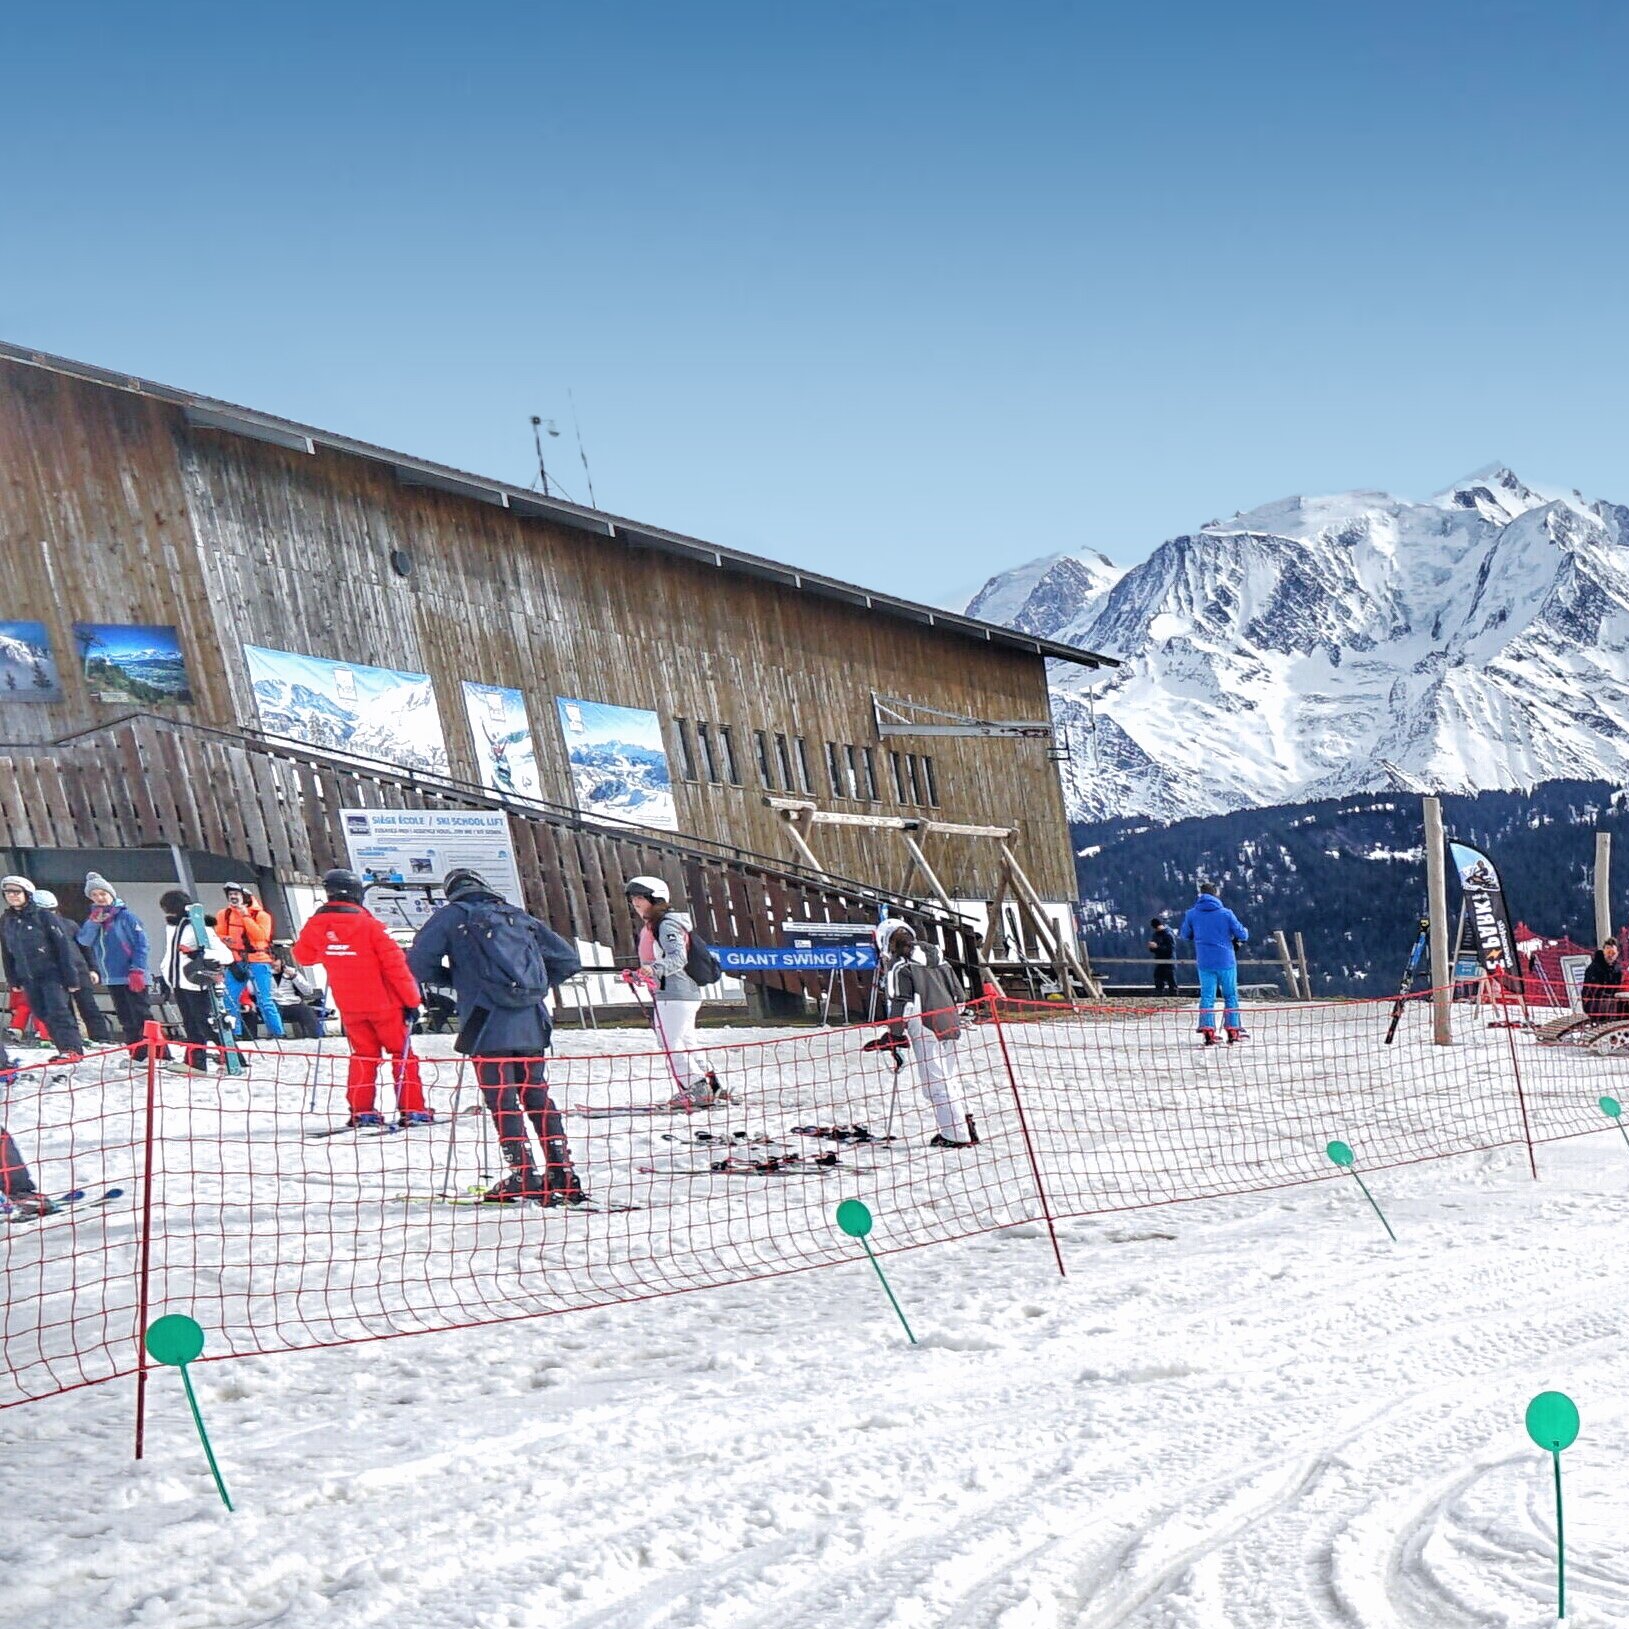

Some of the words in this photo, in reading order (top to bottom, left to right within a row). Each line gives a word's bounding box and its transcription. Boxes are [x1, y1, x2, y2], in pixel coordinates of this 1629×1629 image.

[436, 817, 449, 826] SKI
[451, 817, 485, 826] SCHOOL
[486, 817, 503, 826] LIFT
[726, 952, 778, 966] GIANT
[782, 953, 837, 965] SWING
